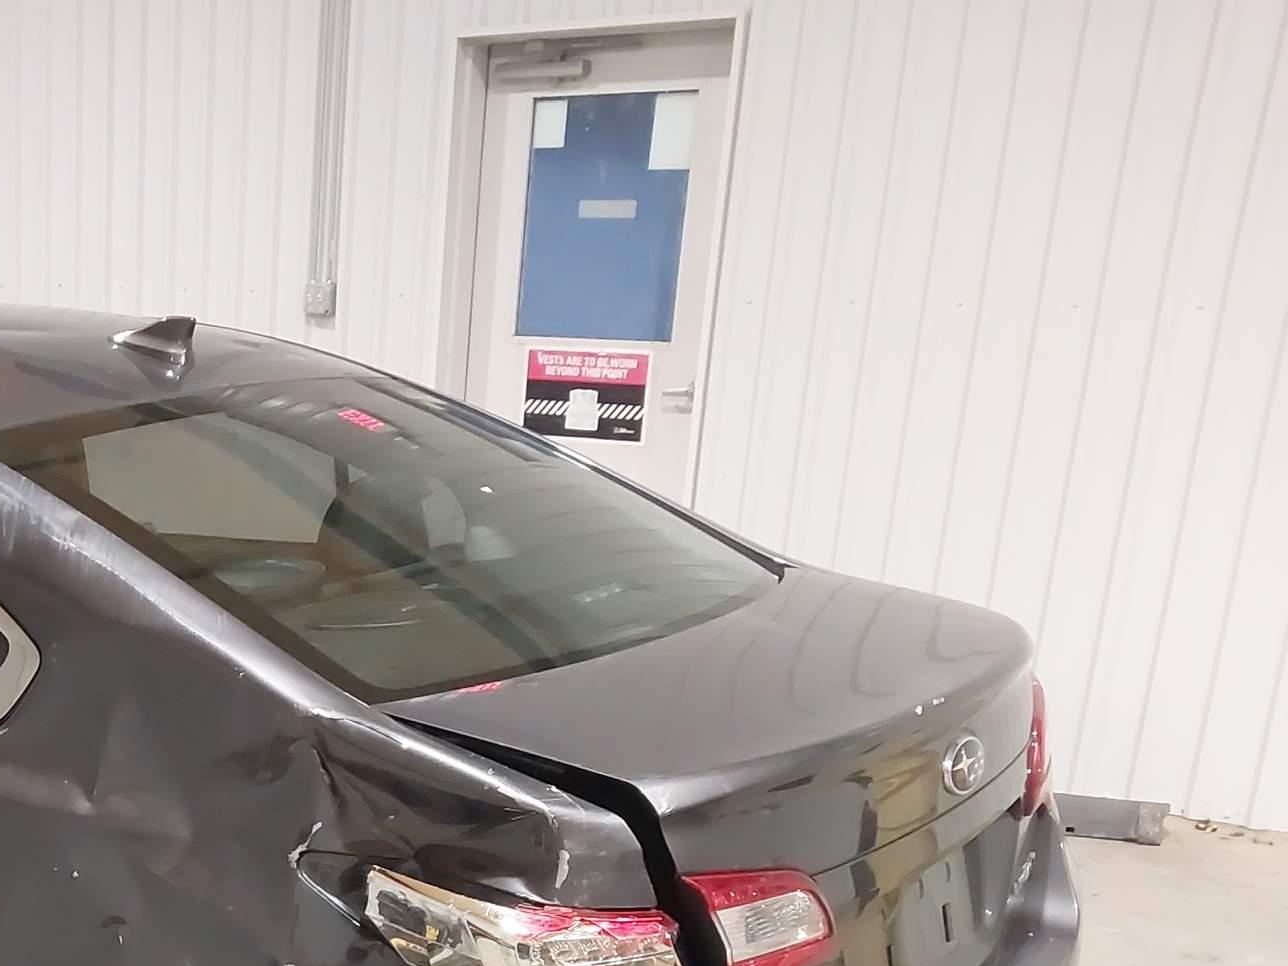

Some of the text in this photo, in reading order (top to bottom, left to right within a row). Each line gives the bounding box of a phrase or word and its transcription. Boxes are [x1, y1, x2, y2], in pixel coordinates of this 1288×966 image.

[566, 355, 583, 366] ARE
[584, 356, 595, 367] TO
[545, 365, 579, 376] BEYOND
